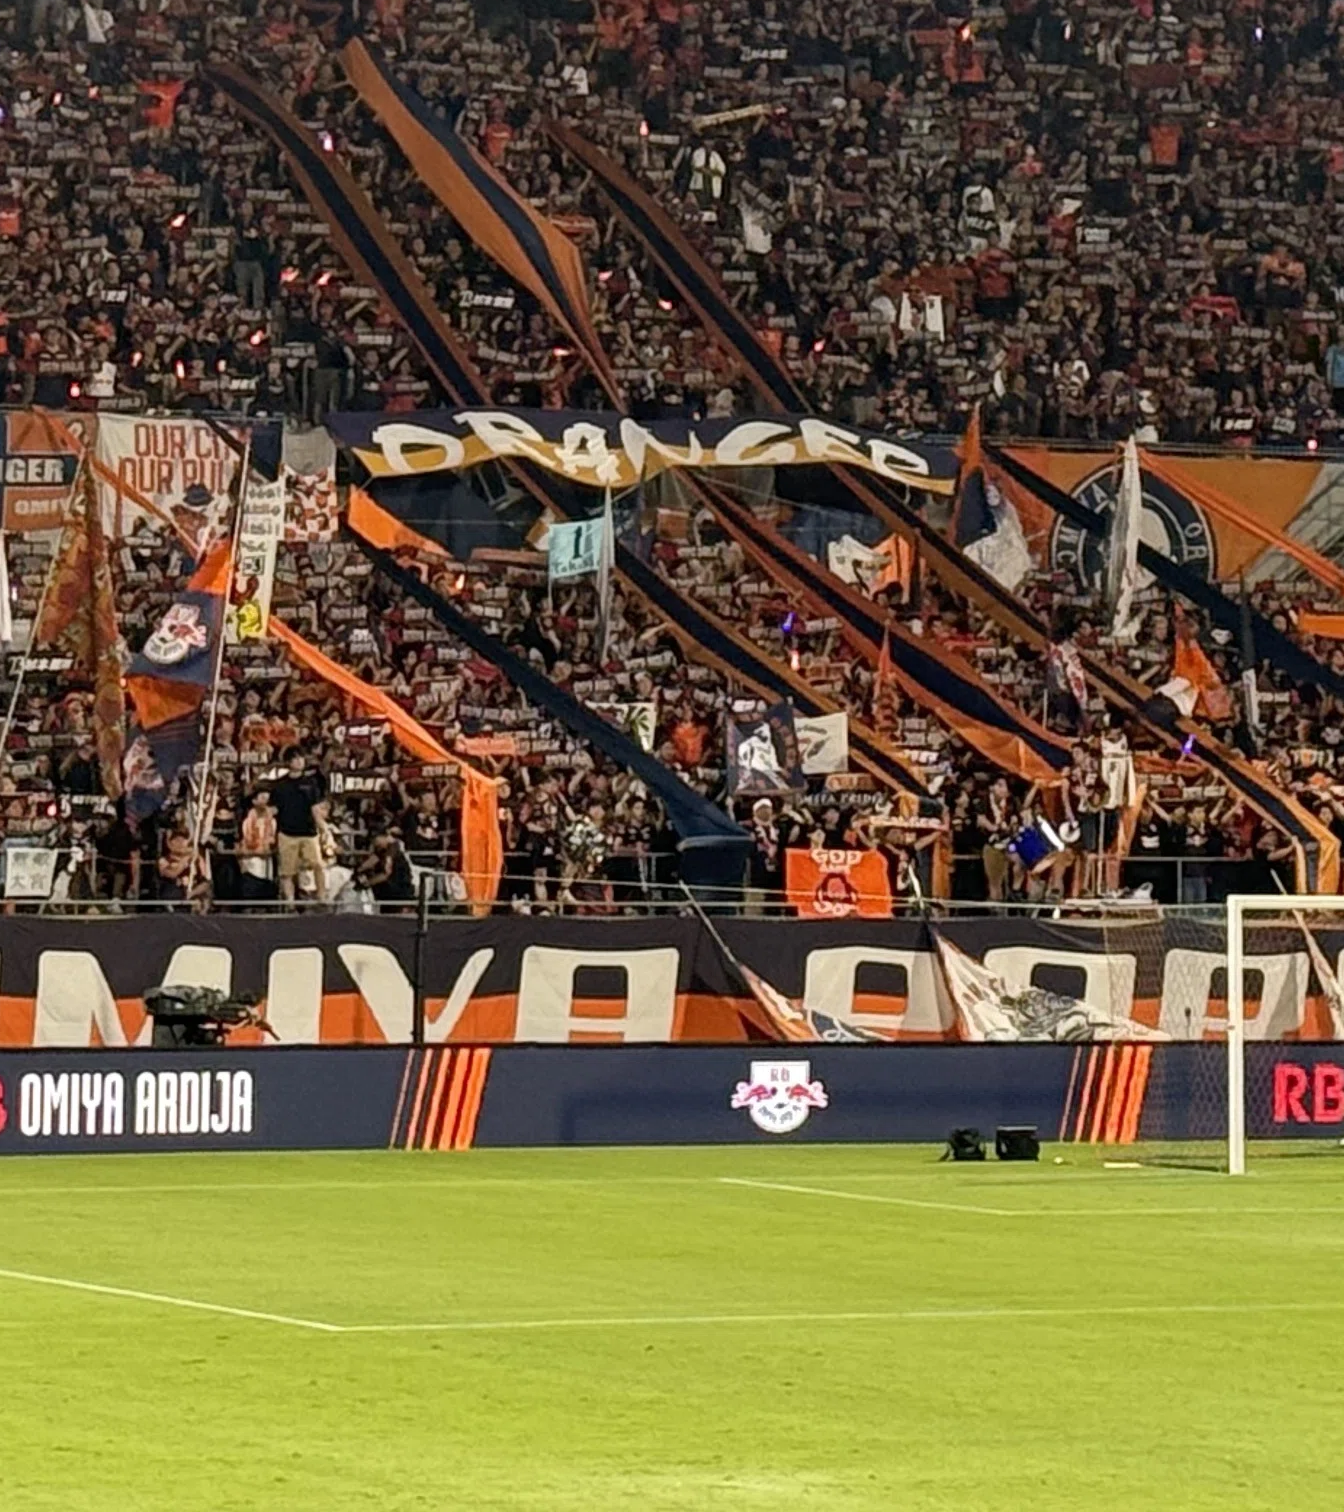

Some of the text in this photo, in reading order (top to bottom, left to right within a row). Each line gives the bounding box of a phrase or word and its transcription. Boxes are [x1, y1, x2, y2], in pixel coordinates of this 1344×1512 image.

[134, 423, 186, 458] OUR
[20, 1071, 124, 1137] OMIYA
[135, 1070, 254, 1136] ARDIJA
